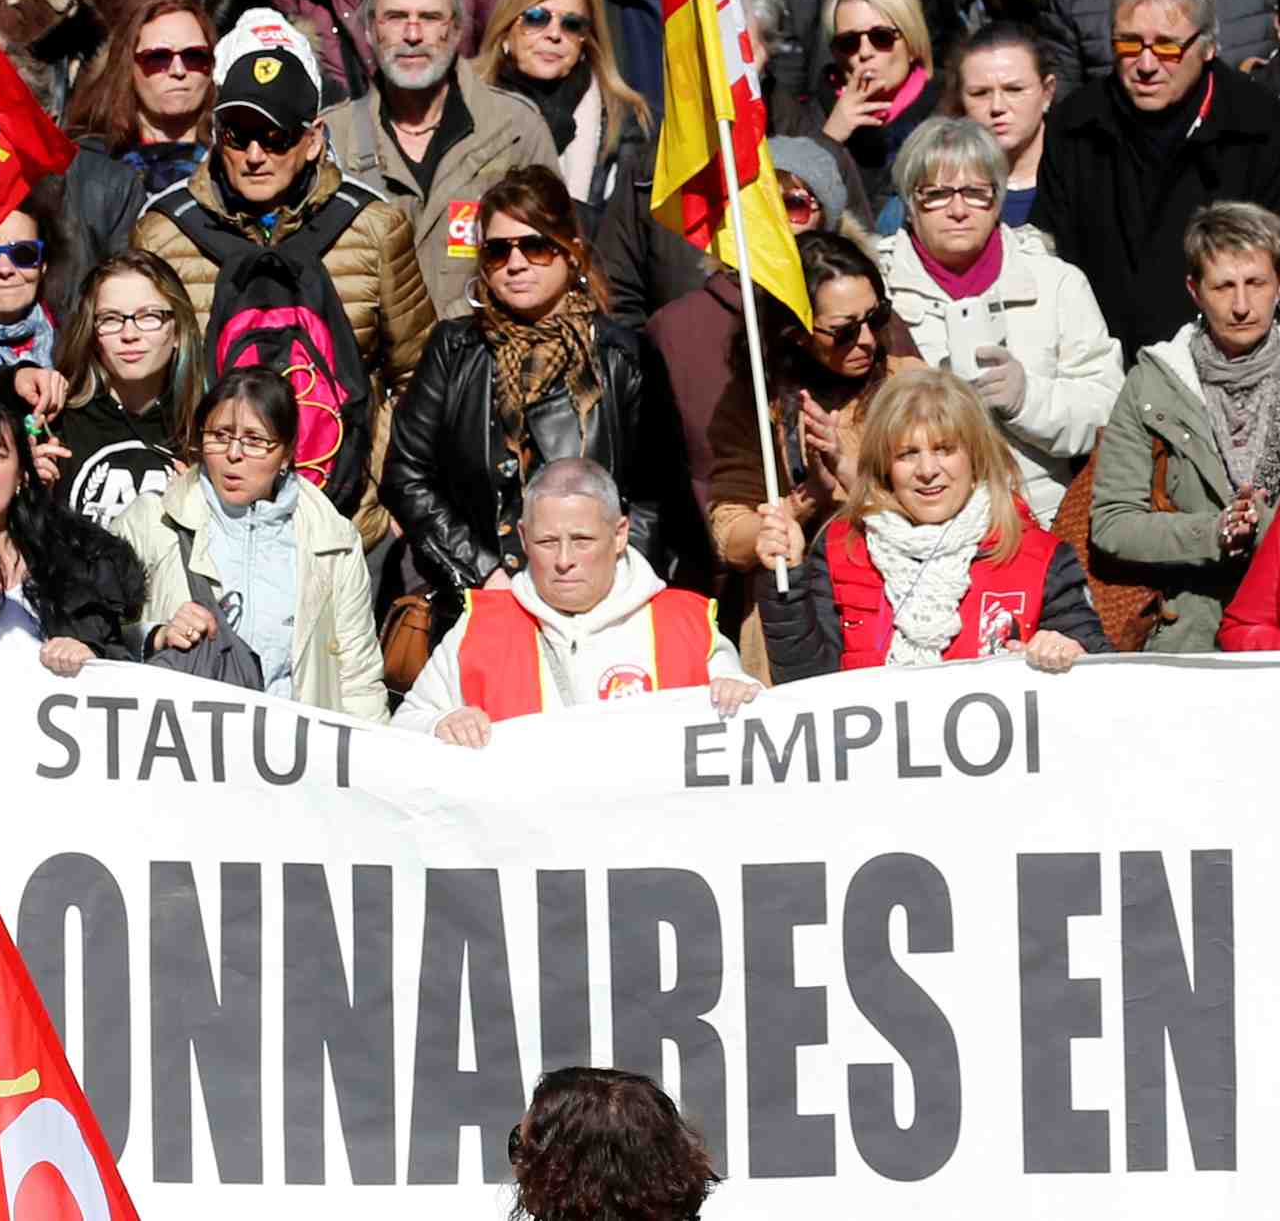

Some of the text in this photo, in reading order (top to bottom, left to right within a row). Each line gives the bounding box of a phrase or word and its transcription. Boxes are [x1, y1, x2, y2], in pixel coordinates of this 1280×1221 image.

[448, 220, 481, 246] cg
[35, 693, 357, 789] STATUT
[683, 689, 1041, 788] EMPLOI
[1016, 849, 1237, 1175] EN
